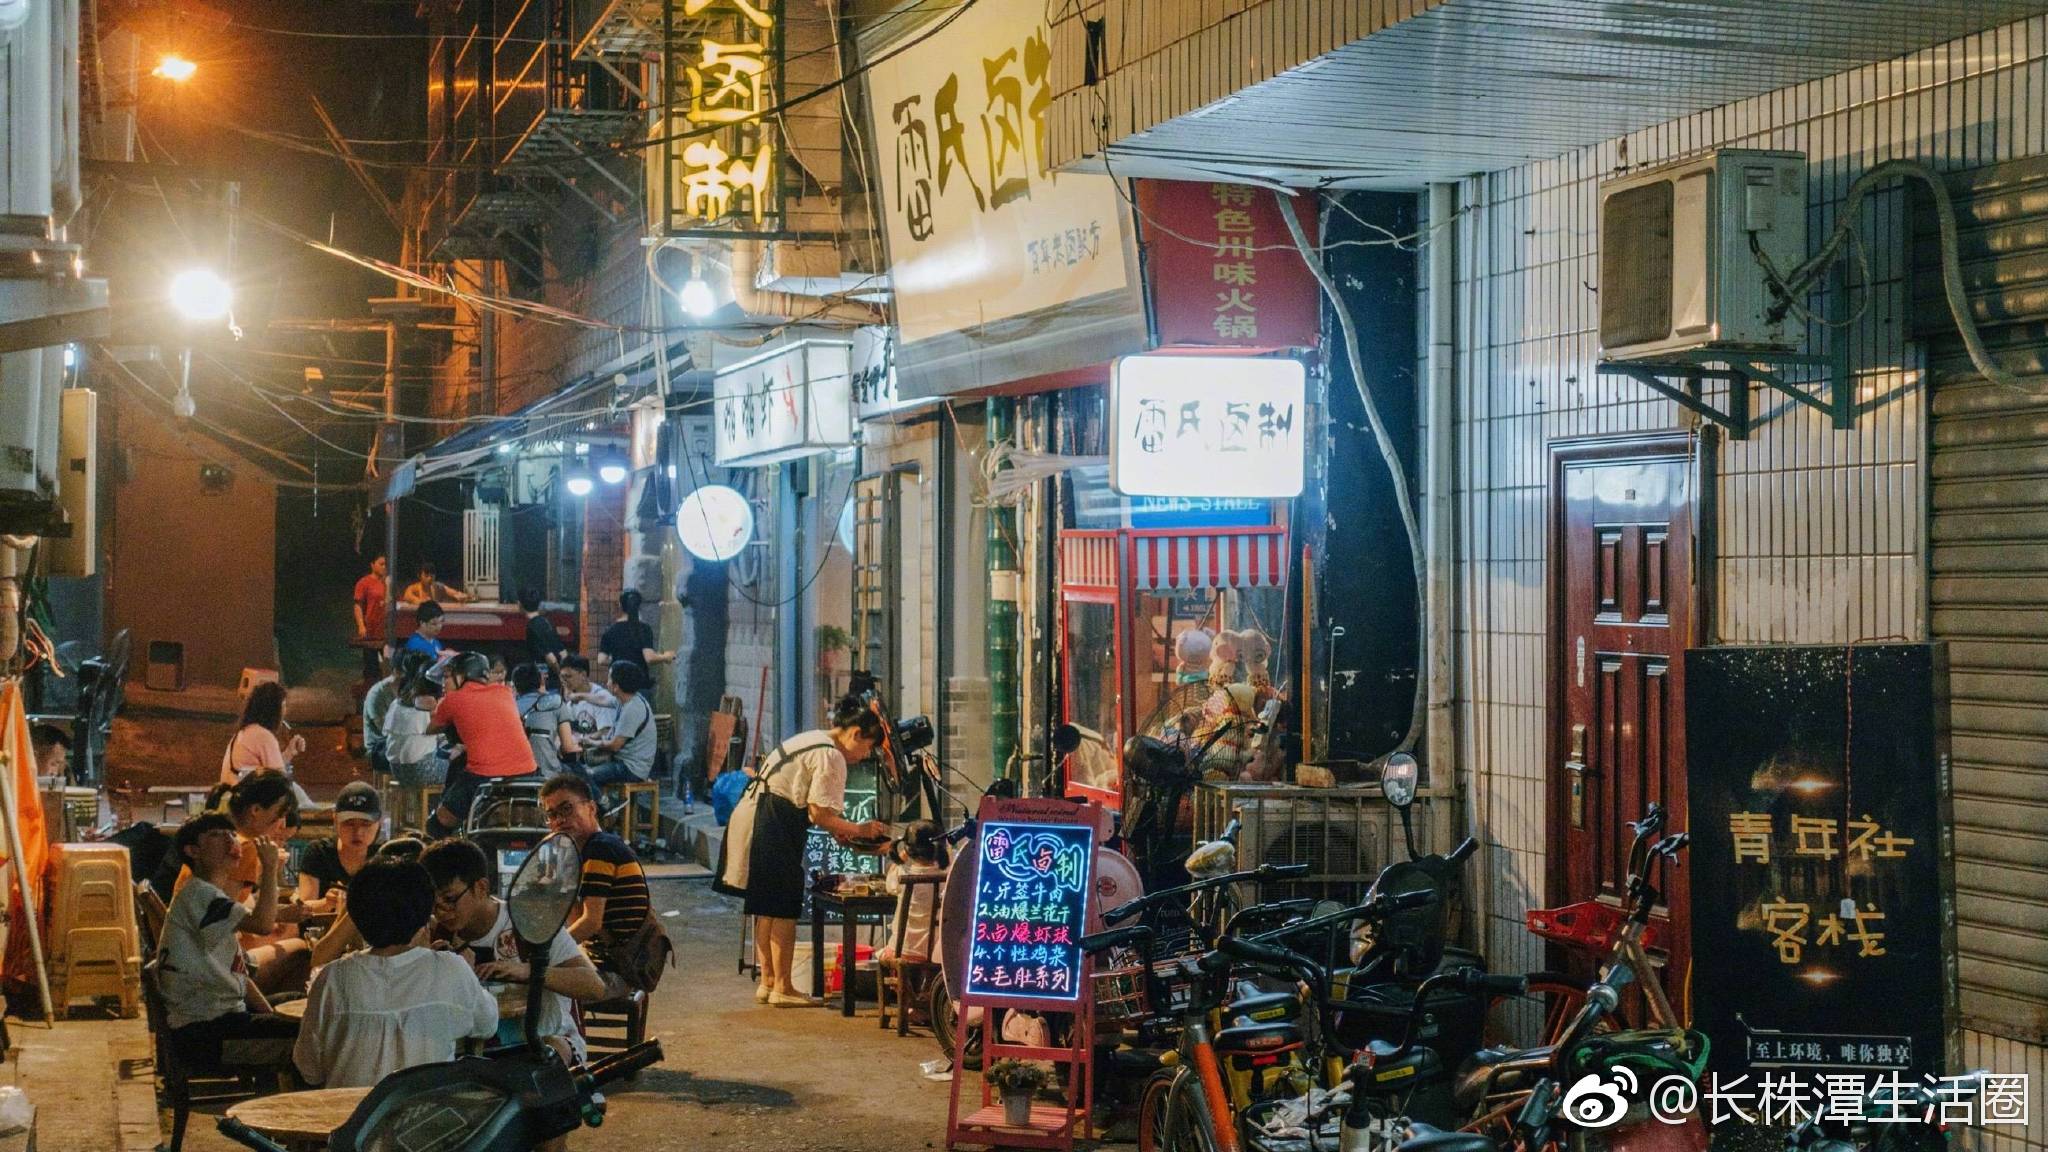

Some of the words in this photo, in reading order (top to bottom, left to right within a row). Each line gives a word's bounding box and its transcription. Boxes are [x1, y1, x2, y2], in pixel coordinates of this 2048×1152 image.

[681, 0, 774, 224] 卤制
[1211, 183, 1258, 339] 特色川味火锅
[1729, 811, 1915, 865] 青年社
[1761, 896, 1887, 963] 客栈
